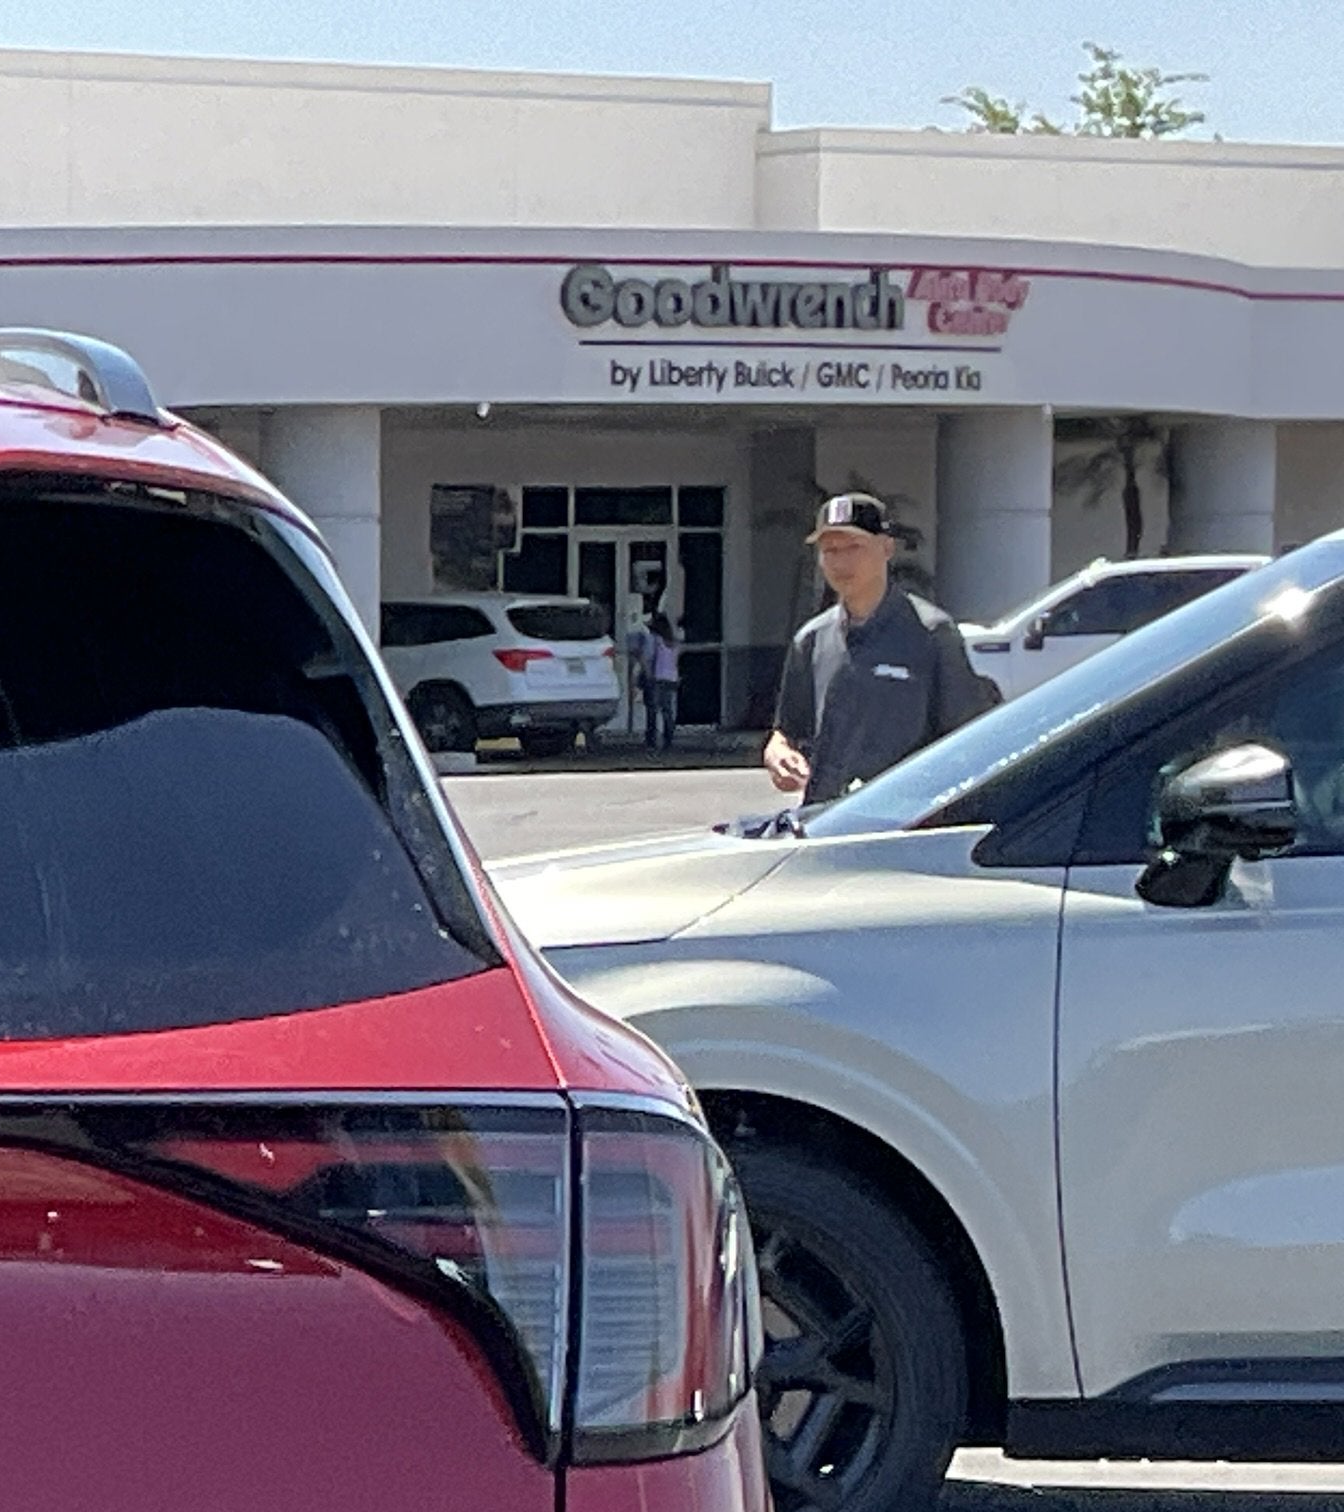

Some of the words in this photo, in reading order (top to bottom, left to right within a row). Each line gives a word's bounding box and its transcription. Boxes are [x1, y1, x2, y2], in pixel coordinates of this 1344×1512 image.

[560, 264, 905, 330] Goodwrench
[610, 358, 641, 392] by
[648, 359, 728, 391] Liberty
[733, 360, 795, 389] Buick
[816, 362, 870, 389] GMC
[891, 363, 950, 391] Peoria
[954, 364, 982, 391] Kia
